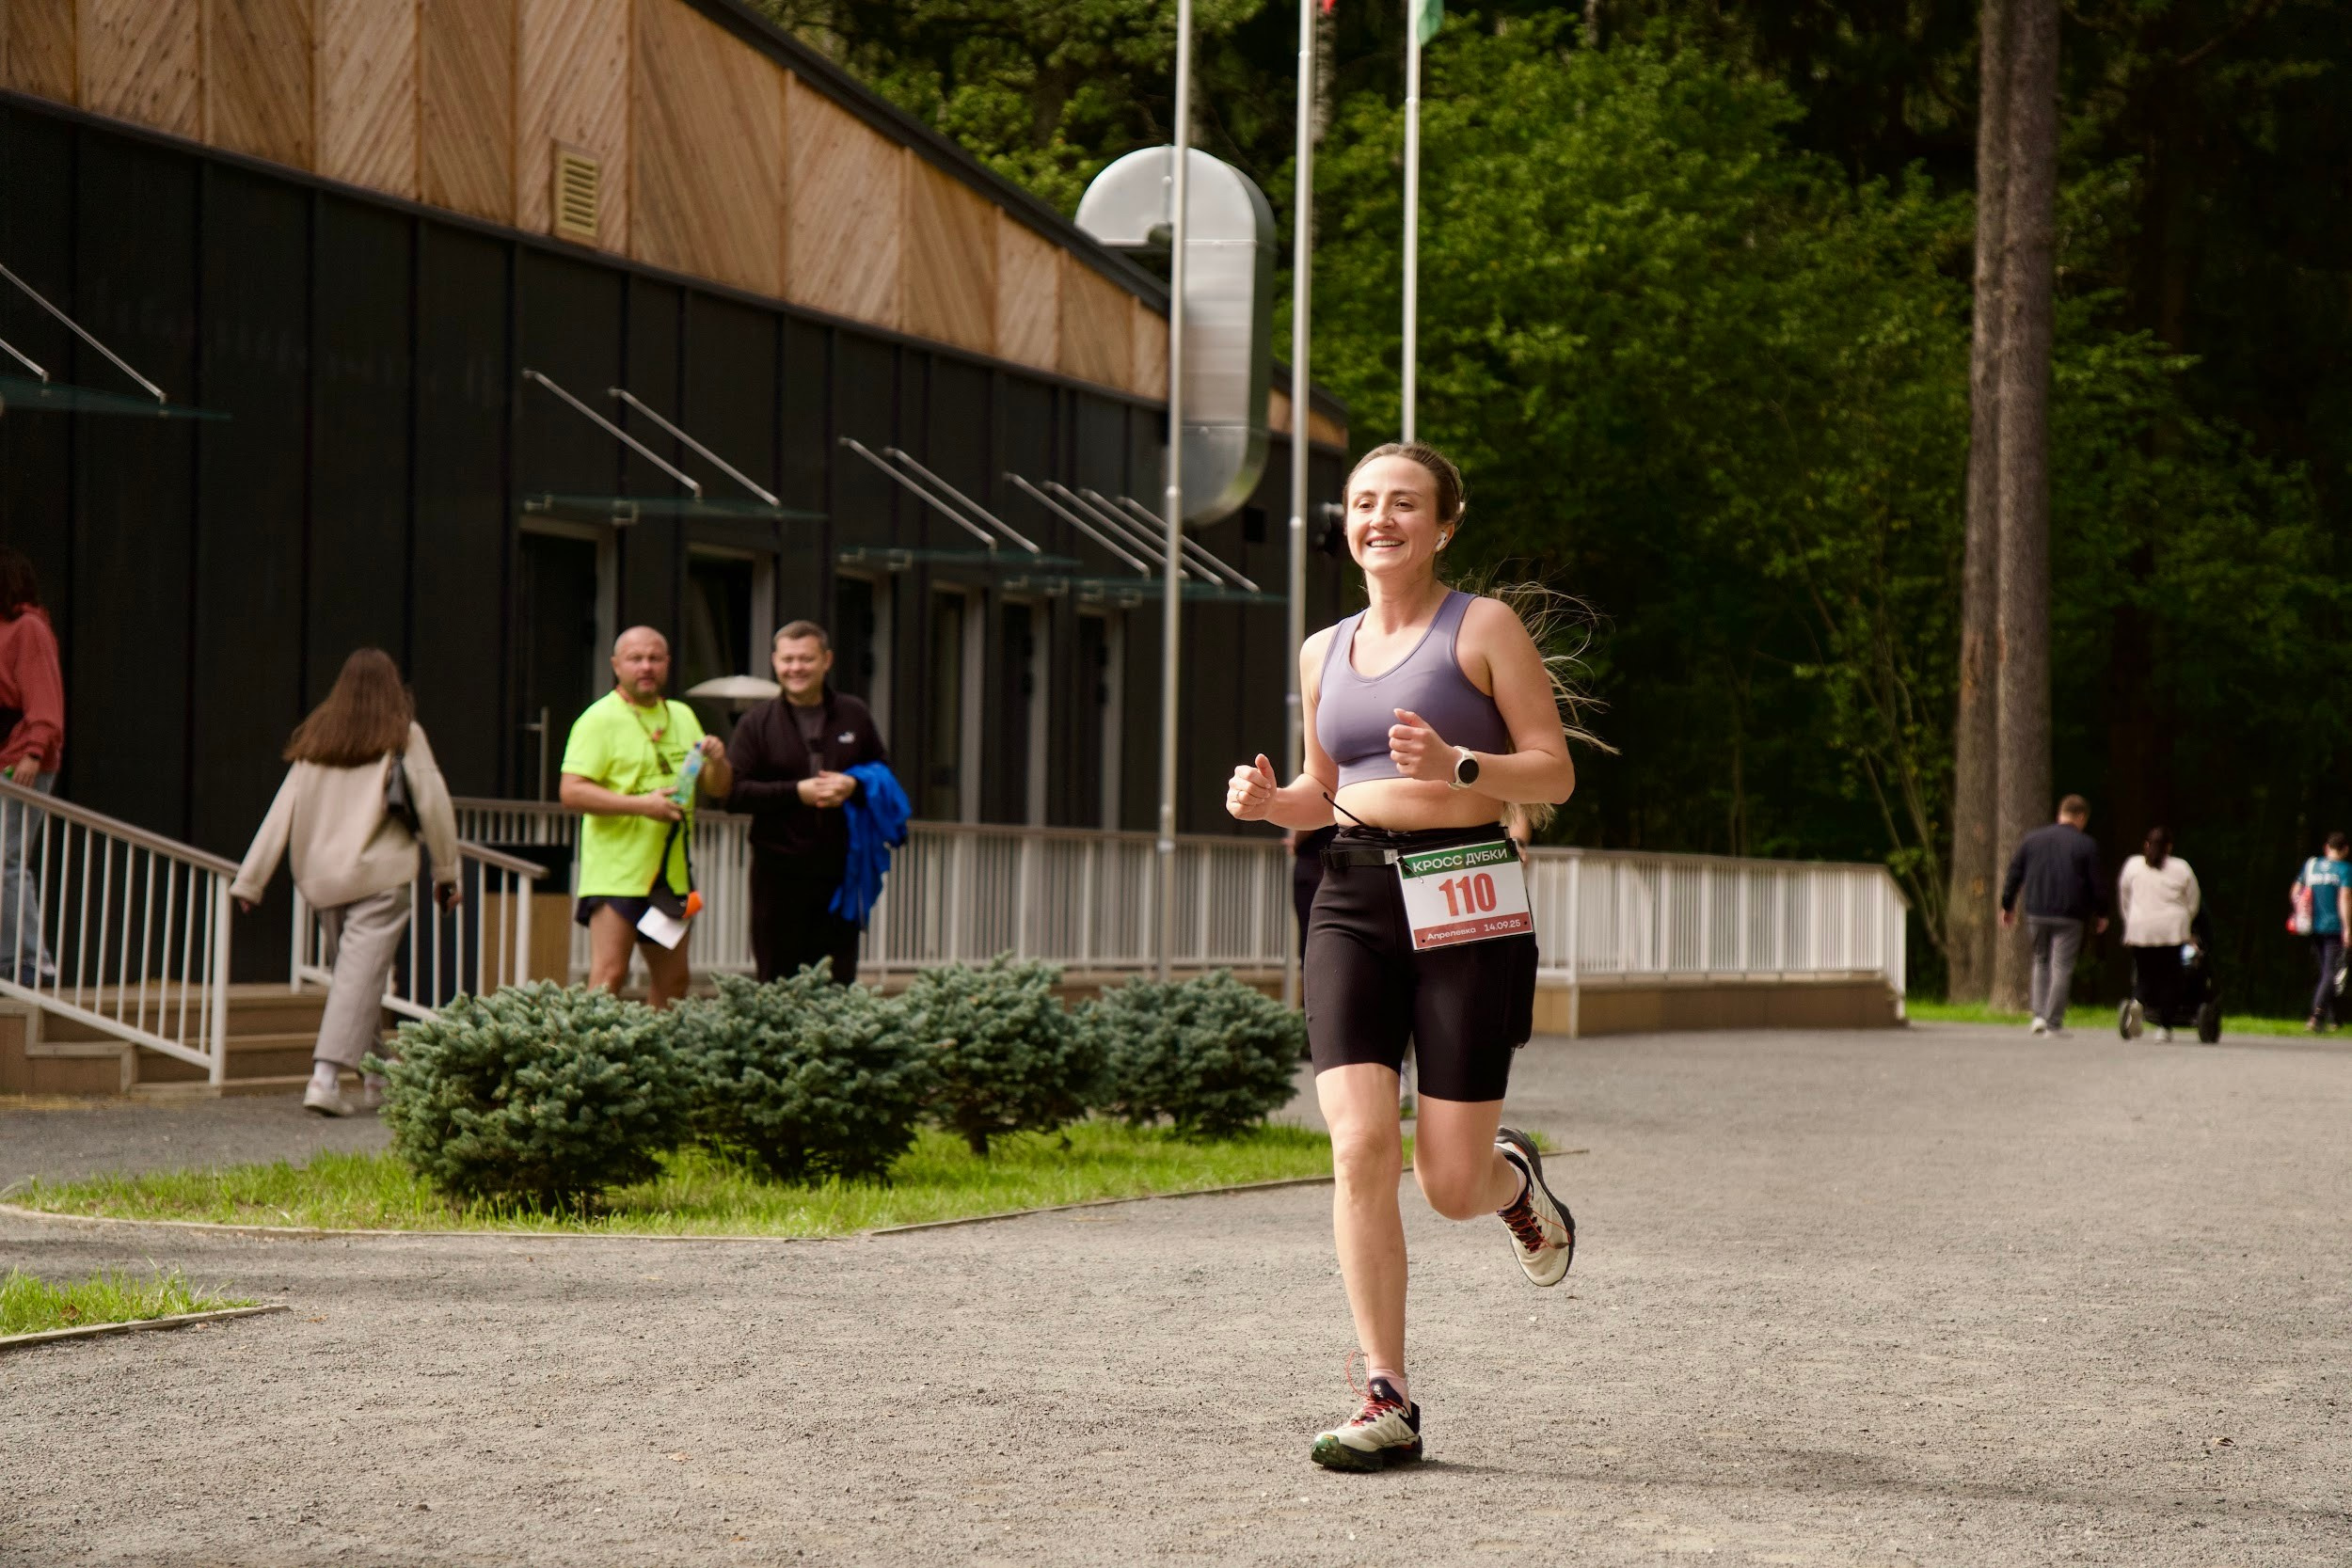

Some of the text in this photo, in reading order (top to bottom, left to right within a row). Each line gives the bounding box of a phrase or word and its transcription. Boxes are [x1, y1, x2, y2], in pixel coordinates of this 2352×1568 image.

[1412, 848, 1508, 873] КРОСС ДУБКИ
[1438, 873, 1497, 917] 110
[1427, 919, 1521, 941] Апрелевка 14.09.25
